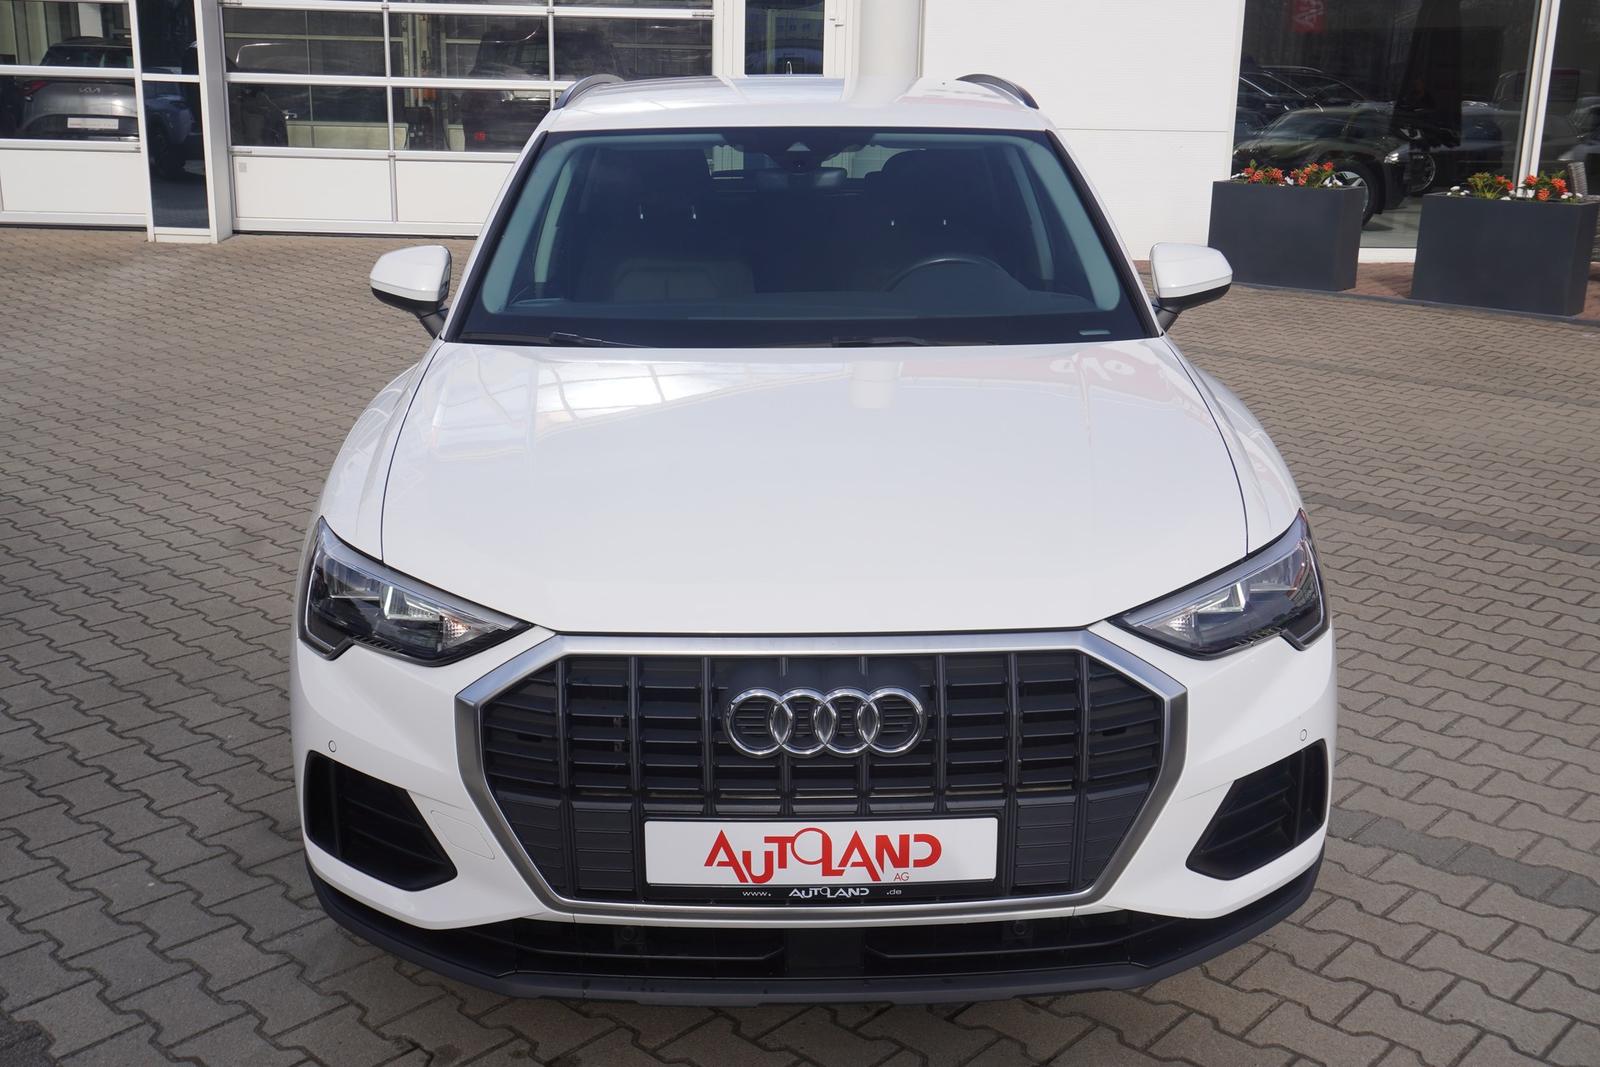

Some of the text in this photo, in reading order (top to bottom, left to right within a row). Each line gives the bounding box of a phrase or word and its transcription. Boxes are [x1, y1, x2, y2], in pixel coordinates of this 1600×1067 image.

[704, 827, 942, 884] AUTOLAND
[893, 872, 910, 882] AG
[788, 886, 870, 899] AUTOLAND
[886, 888, 902, 896] .de
